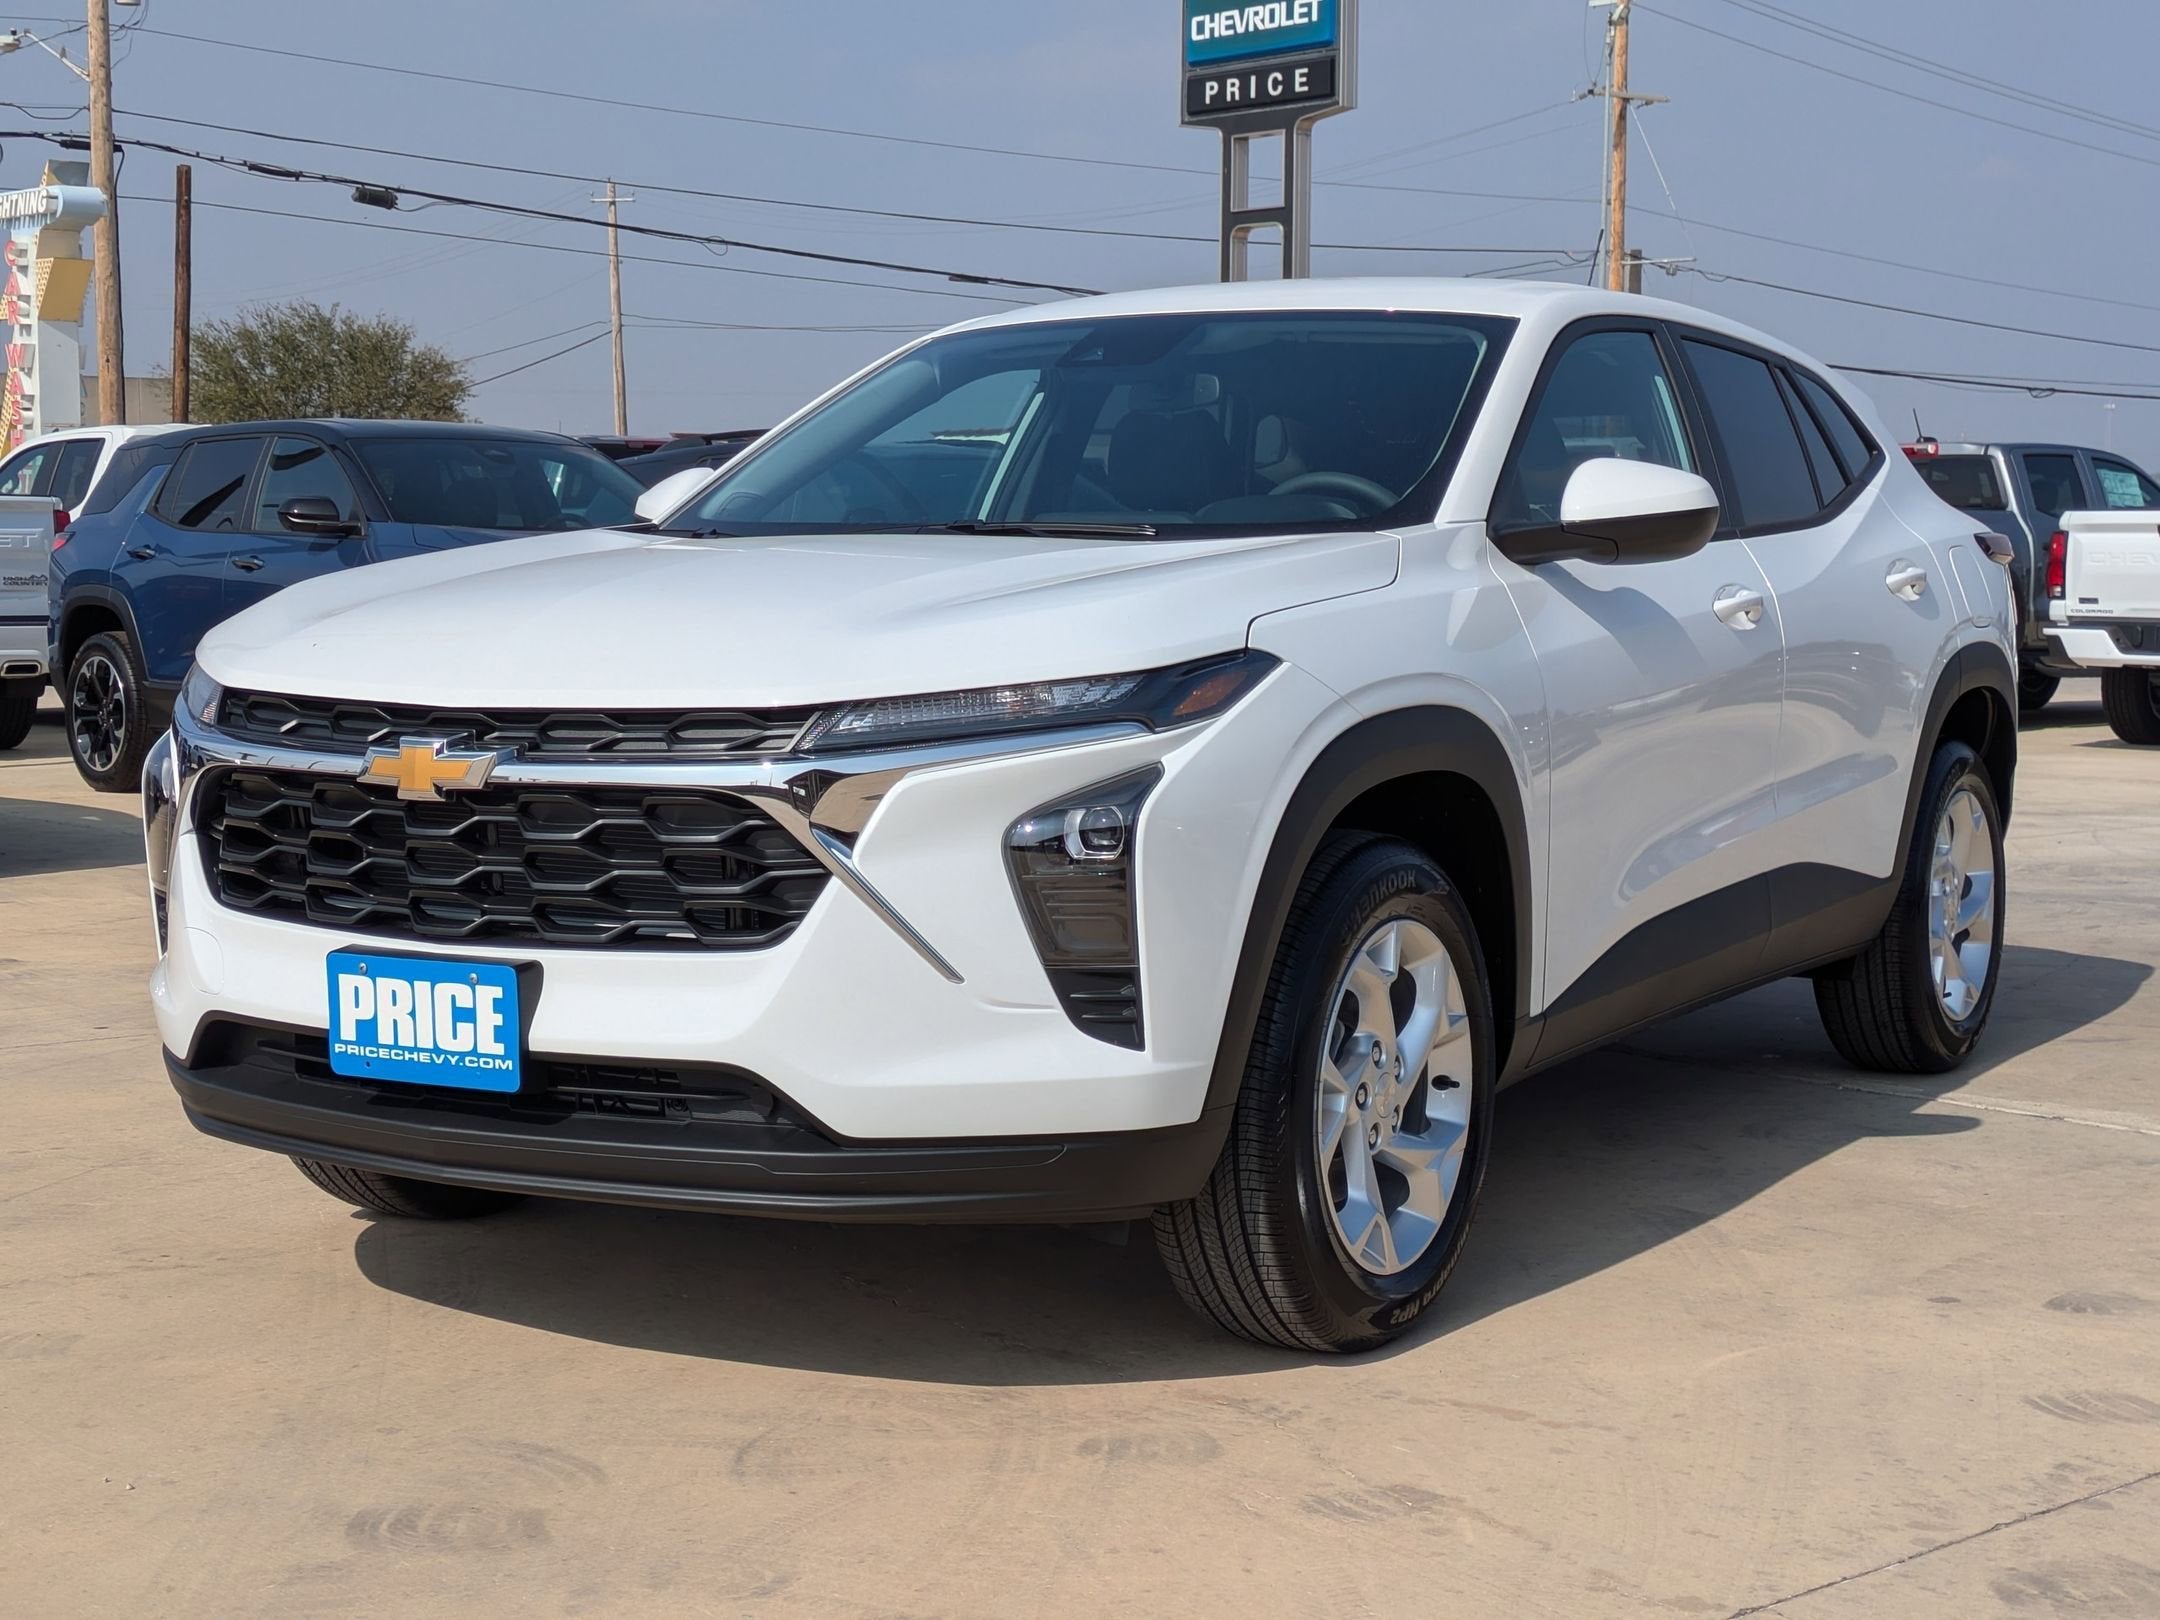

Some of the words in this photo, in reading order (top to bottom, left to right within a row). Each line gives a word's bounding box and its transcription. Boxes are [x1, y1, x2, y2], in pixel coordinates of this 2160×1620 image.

[1191, 0, 1323, 41] CHEVROLET
[1205, 68, 1309, 105] PRICE
[0, 188, 47, 219] HTNING
[5, 240, 21, 326] CAR
[337, 973, 505, 1056] PRICE
[334, 1043, 513, 1071] PRICECHEVY.COM
